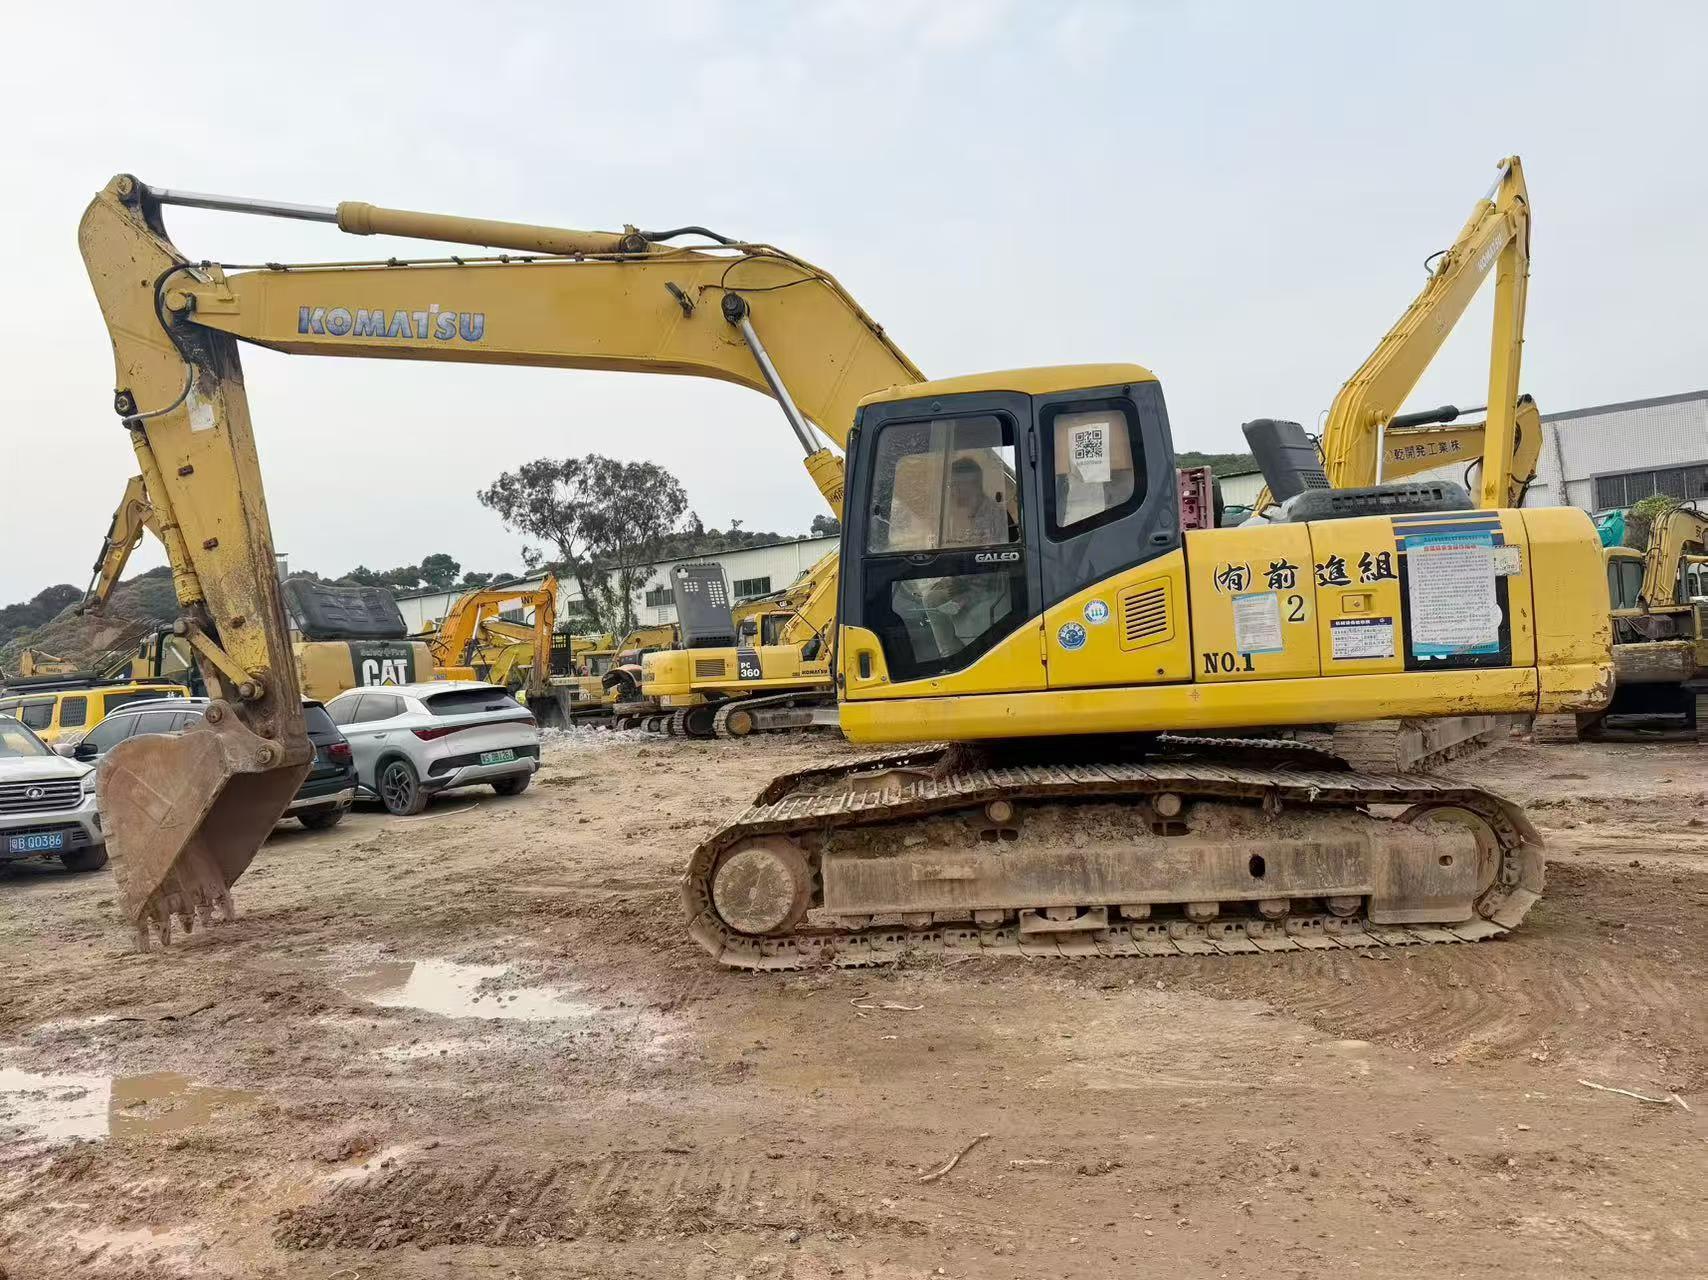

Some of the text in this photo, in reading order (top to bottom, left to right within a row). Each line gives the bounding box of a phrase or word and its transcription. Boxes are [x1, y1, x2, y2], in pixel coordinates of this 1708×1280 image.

[298, 304, 485, 342] KOMATSU
[975, 552, 1020, 562] GALEO
[1287, 595, 1305, 622] 2
[362, 659, 408, 686] CAT
[741, 669, 760, 677] 360
[1203, 652, 1255, 674] NO.1
